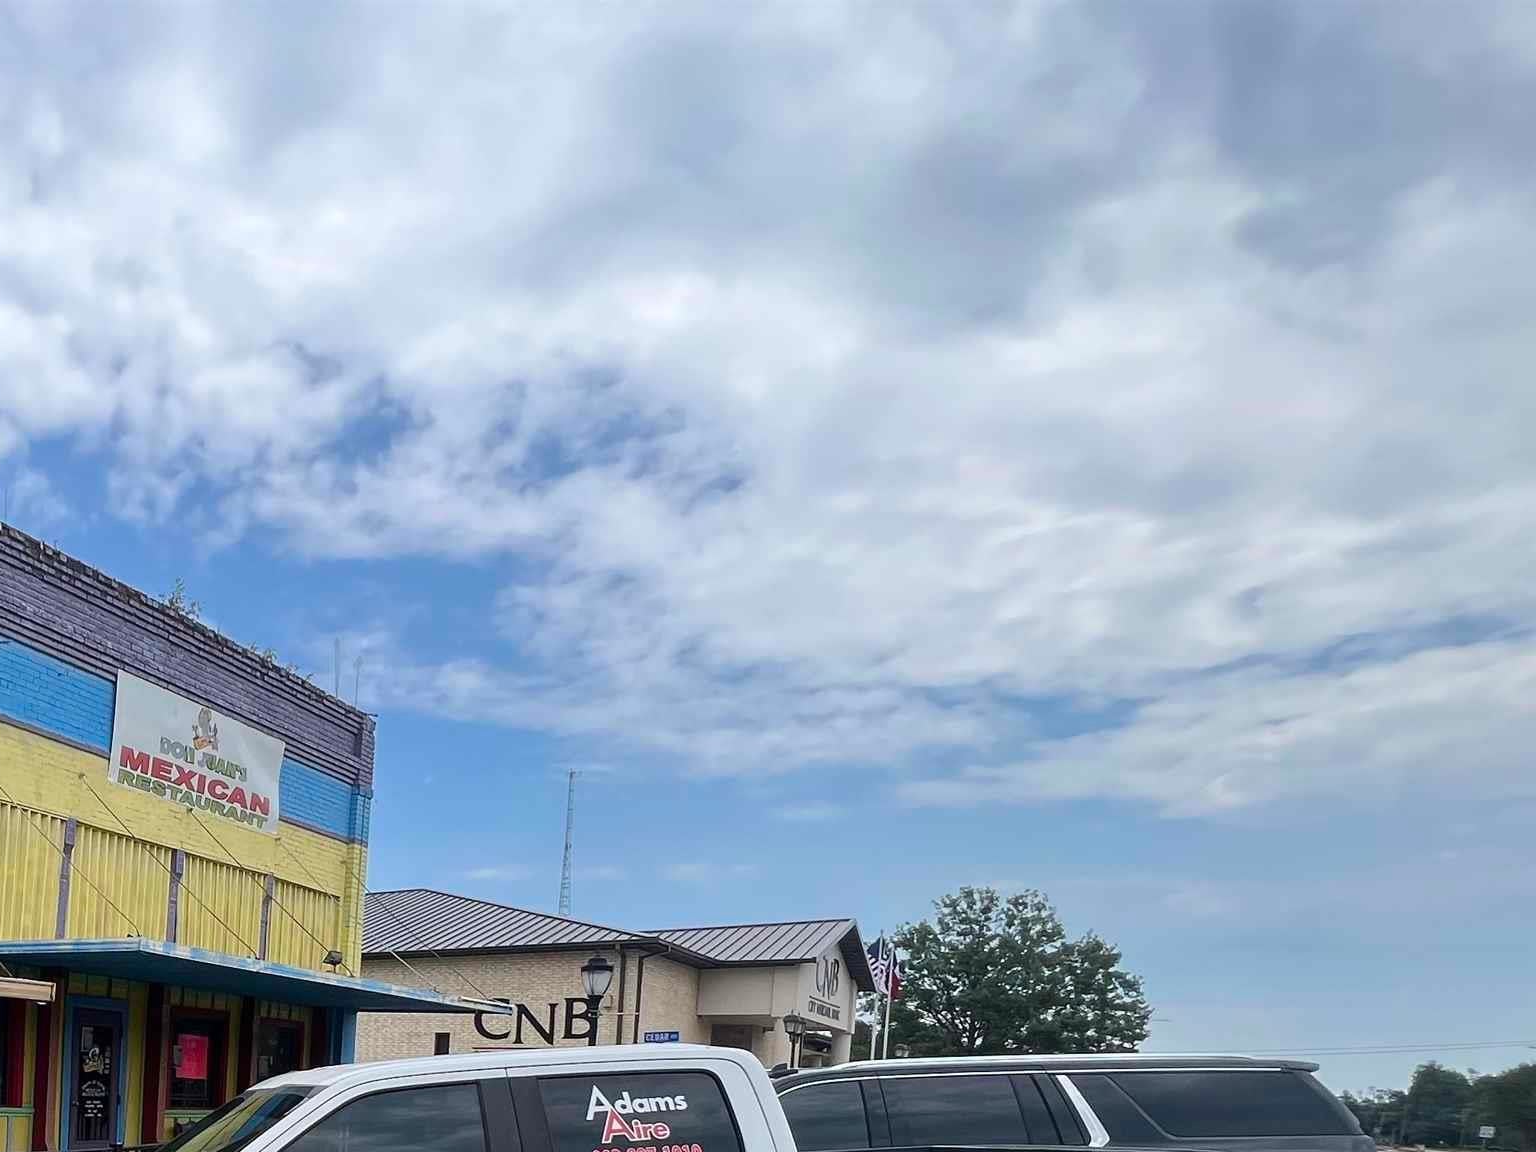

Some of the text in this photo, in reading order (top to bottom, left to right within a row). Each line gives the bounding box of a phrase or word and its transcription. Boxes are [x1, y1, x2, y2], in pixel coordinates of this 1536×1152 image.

[117, 768, 268, 829] RESTAURANT
[119, 745, 270, 816] MEXICAN
[815, 955, 839, 1000] CNB
[473, 997, 594, 1045] CNB
[586, 1084, 688, 1120] Adams
[601, 1106, 670, 1144] Aire
